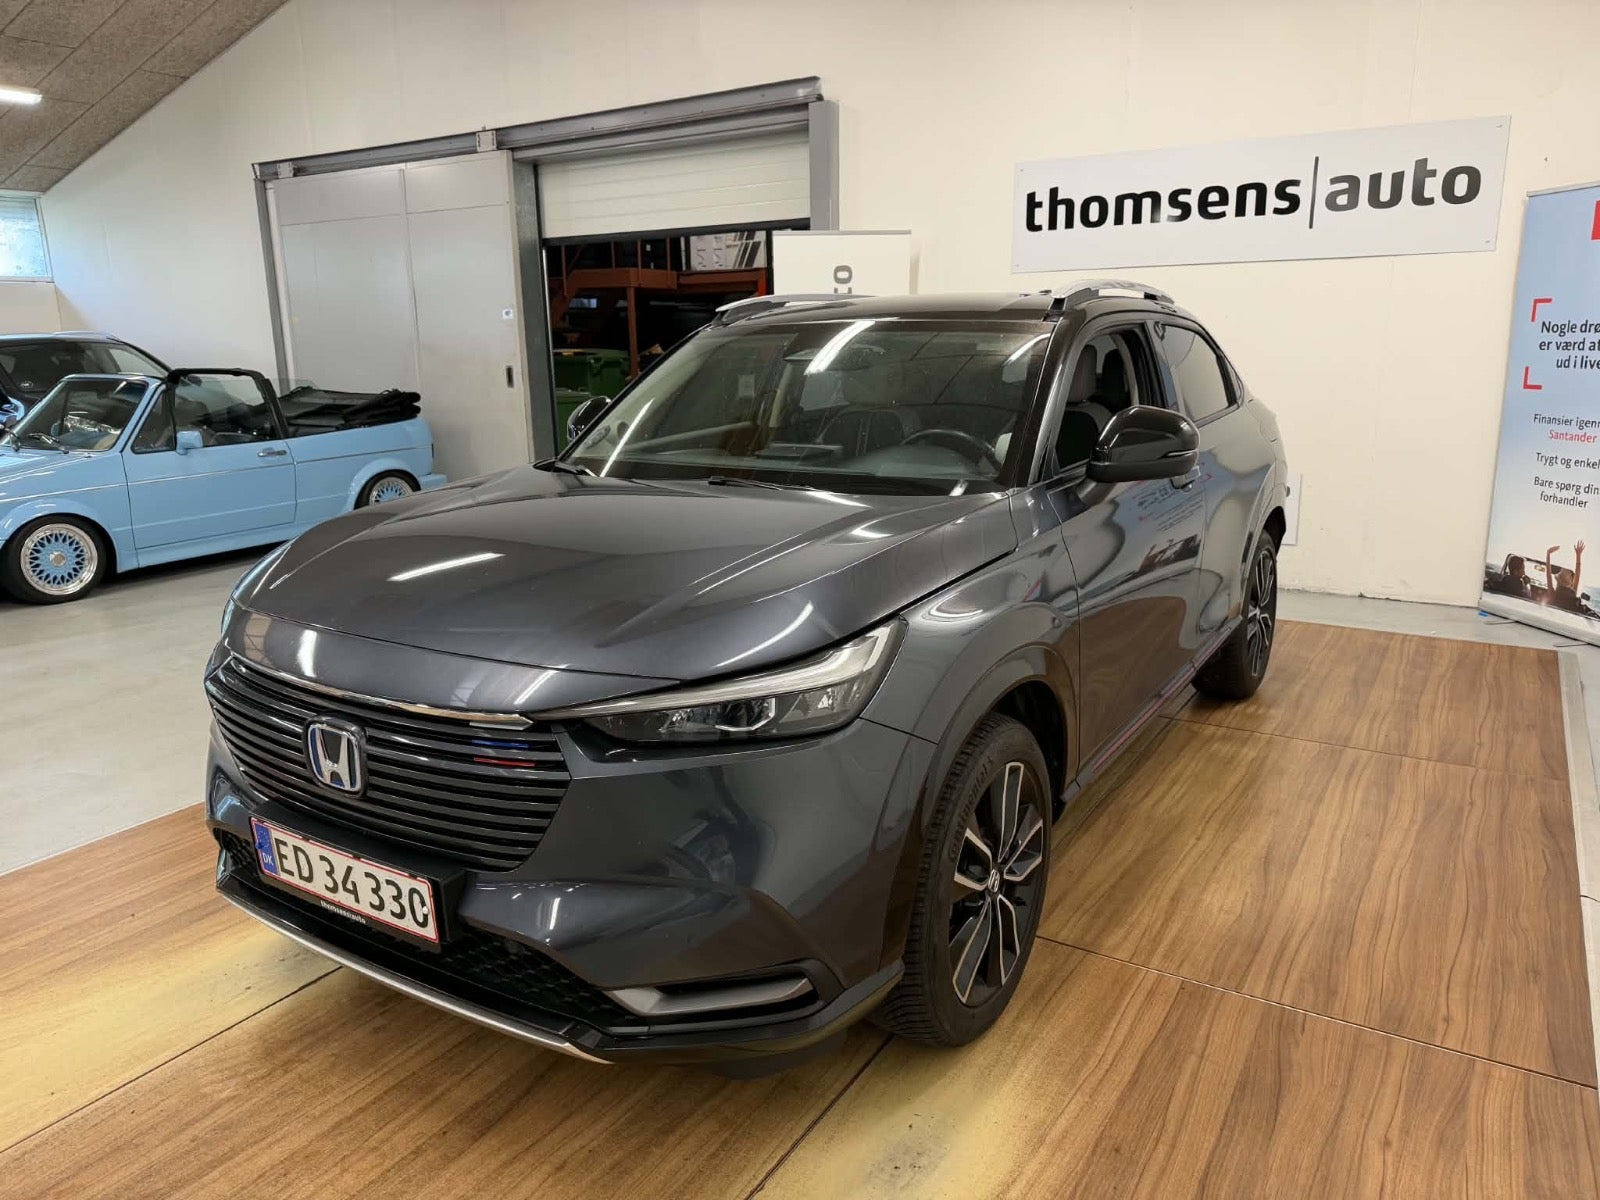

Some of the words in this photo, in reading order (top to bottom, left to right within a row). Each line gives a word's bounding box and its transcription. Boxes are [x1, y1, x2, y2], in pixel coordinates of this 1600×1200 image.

[1541, 320, 1577, 337] Nogle
[1538, 341, 1553, 351] er
[1555, 337, 1586, 351] værd
[1556, 355, 1571, 369] ud
[1573, 355, 1578, 369] i
[1533, 413, 1573, 426] Finansier
[1548, 429, 1598, 444] Santander
[1536, 452, 1559, 467] Trygt
[1560, 457, 1572, 469] og
[1534, 476, 1554, 488] Bare
[1555, 481, 1582, 495] spørg
[1584, 483, 1599, 495] din
[1540, 490, 1588, 508] forhandler
[262, 852, 274, 866] DK
[274, 837, 314, 883] ED
[319, 854, 360, 904] 34
[364, 871, 429, 929] 330
